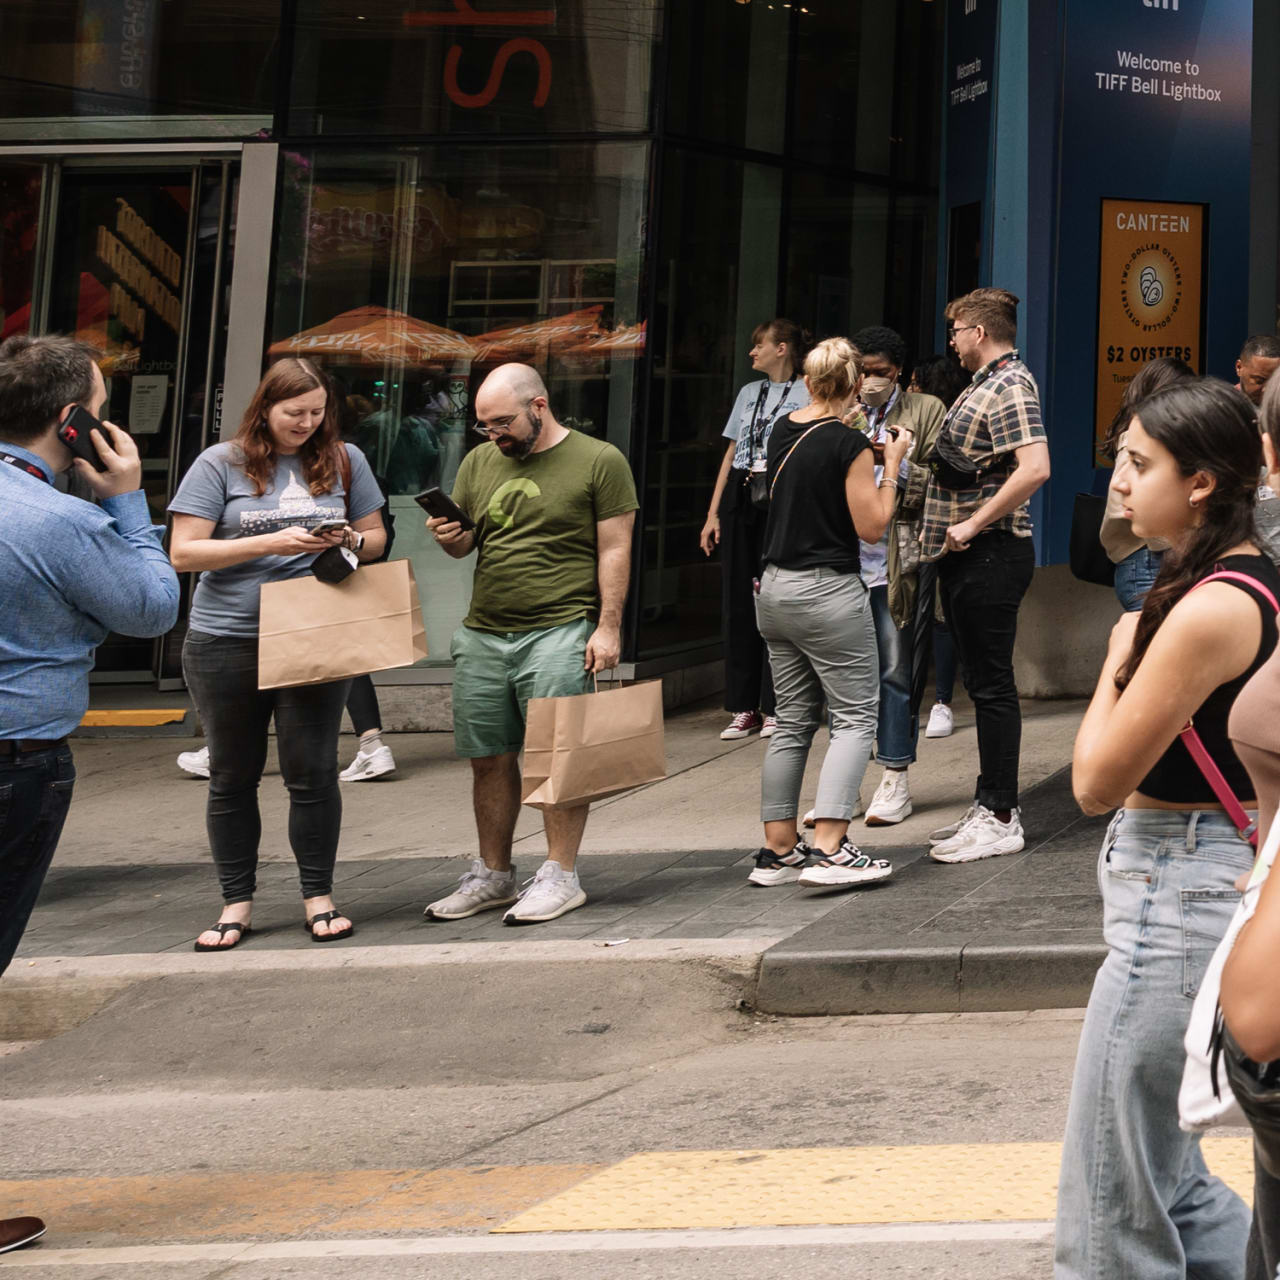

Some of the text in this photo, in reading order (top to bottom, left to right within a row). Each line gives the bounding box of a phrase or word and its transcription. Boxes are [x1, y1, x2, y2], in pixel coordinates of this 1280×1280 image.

[1117, 50, 1200, 76] Welcome to
[1096, 72, 1222, 103] TIFF Bell Lightbox
[1117, 213, 1190, 232] CANTEEN
[1121, 242, 1182, 286] TWO-DOLLAR OYSTERS
[1121, 289, 1141, 328] OYSTERS
[1107, 345, 1125, 363] $2
